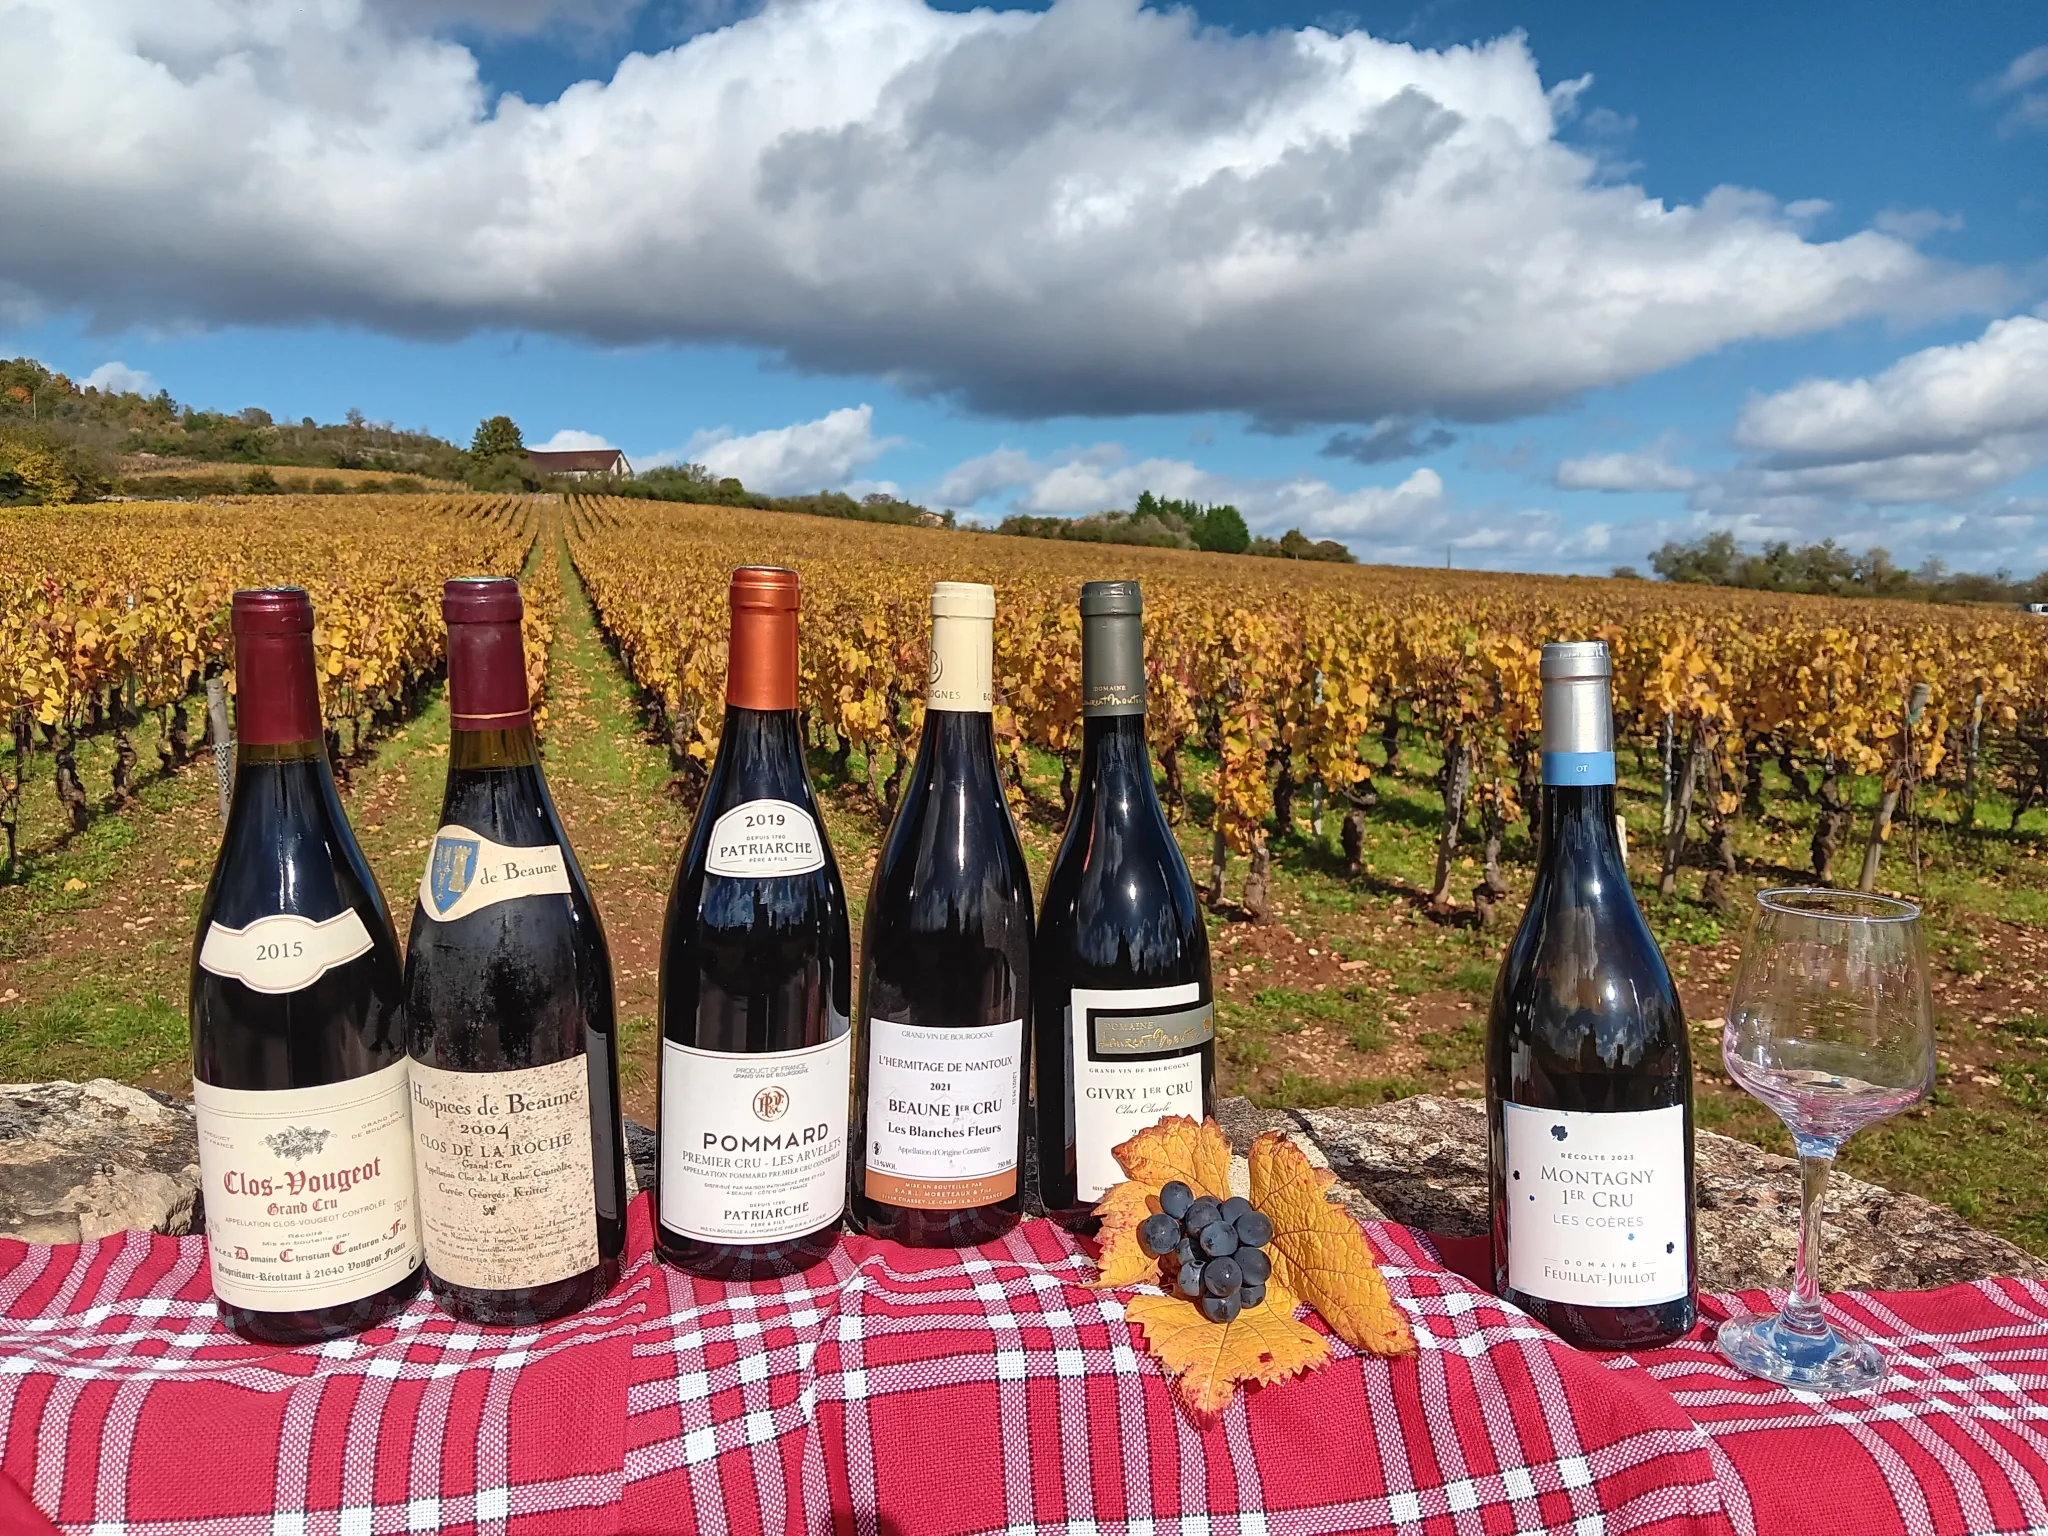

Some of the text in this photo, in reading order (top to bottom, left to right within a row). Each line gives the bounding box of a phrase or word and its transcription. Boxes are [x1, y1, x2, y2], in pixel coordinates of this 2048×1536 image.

[927, 689, 961, 700] OGNES
[1093, 684, 1127, 692] DOMAINE
[744, 813, 786, 828] 2019
[719, 842, 813, 858] PATRIARCHE
[480, 861, 558, 885] de Beaune
[255, 941, 304, 961] 2015
[1103, 1021, 1155, 1032] DOMAINE
[901, 1030, 994, 1041] GRAND VIN DE BOURGOGNE
[735, 1067, 769, 1075] PRODUCT
[780, 1062, 807, 1071] FRANCE
[878, 1054, 1013, 1072] L'HERMITAGE DE NANTOUX
[1148, 1062, 1190, 1073] BOURGOGNE
[775, 1068, 809, 1078] BOURGOGNE
[929, 1082, 951, 1092] 2021
[1085, 1081, 1194, 1100] GIVRY 1ER CRU
[412, 1080, 580, 1119] Hospices de Beaune
[888, 1099, 1003, 1117] BEAUNE 1ER CRU
[1115, 1103, 1139, 1115] Clos
[351, 1112, 406, 1140] DE BOURGOGNE
[361, 1110, 399, 1130] GRAND VIN
[460, 1121, 510, 1139] 2004
[703, 1122, 829, 1152] POMMARD
[888, 1121, 1002, 1138] Les Blanches Fleurs
[420, 1133, 574, 1159] CLOS DE LA ROCHE
[682, 1136, 842, 1169] PREMIER CRU LES ARVELETS
[897, 1145, 991, 1158] Appellation d'Origine Contrôlée
[1560, 1151, 1606, 1161] RÉCOLTE
[425, 1161, 455, 1179] Appellation
[457, 1171, 475, 1181] Clos
[478, 1173, 487, 1181] de
[490, 1172, 498, 1182] la
[500, 1171, 530, 1182] Roche
[461, 1159, 513, 1171] Grand Cru
[683, 1150, 841, 1180] APPELLATION POMMARD PREMIER CRU CONTRÔLÉE
[223, 1156, 381, 1197] Clos-Vougeot
[1540, 1164, 1655, 1186] MONTAGNY
[438, 1182, 463, 1197] Cuvée
[766, 1179, 798, 1189] PATRIARCHE
[790, 1183, 808, 1191] FRANCE
[924, 1190, 971, 1198] MORETEAUX
[982, 1192, 1003, 1200] FRANCE
[1561, 1189, 1634, 1208] 1ER CRU
[225, 1216, 271, 1228] APPELLATION
[273, 1213, 339, 1228] CLOS-VOUGEOT
[342, 1199, 386, 1219] CONTRÔLÉE
[267, 1198, 338, 1216] Grand Cru
[724, 1201, 810, 1221] PATRIARCHE
[1553, 1213, 1644, 1228] LES COÈRES
[287, 1230, 323, 1240] Récolté
[293, 1235, 333, 1246] bouteille
[336, 1232, 351, 1240] par
[233, 1245, 278, 1263] Domaine
[279, 1248, 330, 1263] Christian
[305, 1270, 311, 1280] à
[314, 1265, 345, 1279] 21640
[347, 1253, 382, 1272] Vougeot
[383, 1241, 406, 1261] France
[1564, 1259, 1638, 1268] DOMAINE
[483, 1274, 512, 1285] FRANCE
[1543, 1266, 1657, 1288] FEUILLAT-JUILLOT
